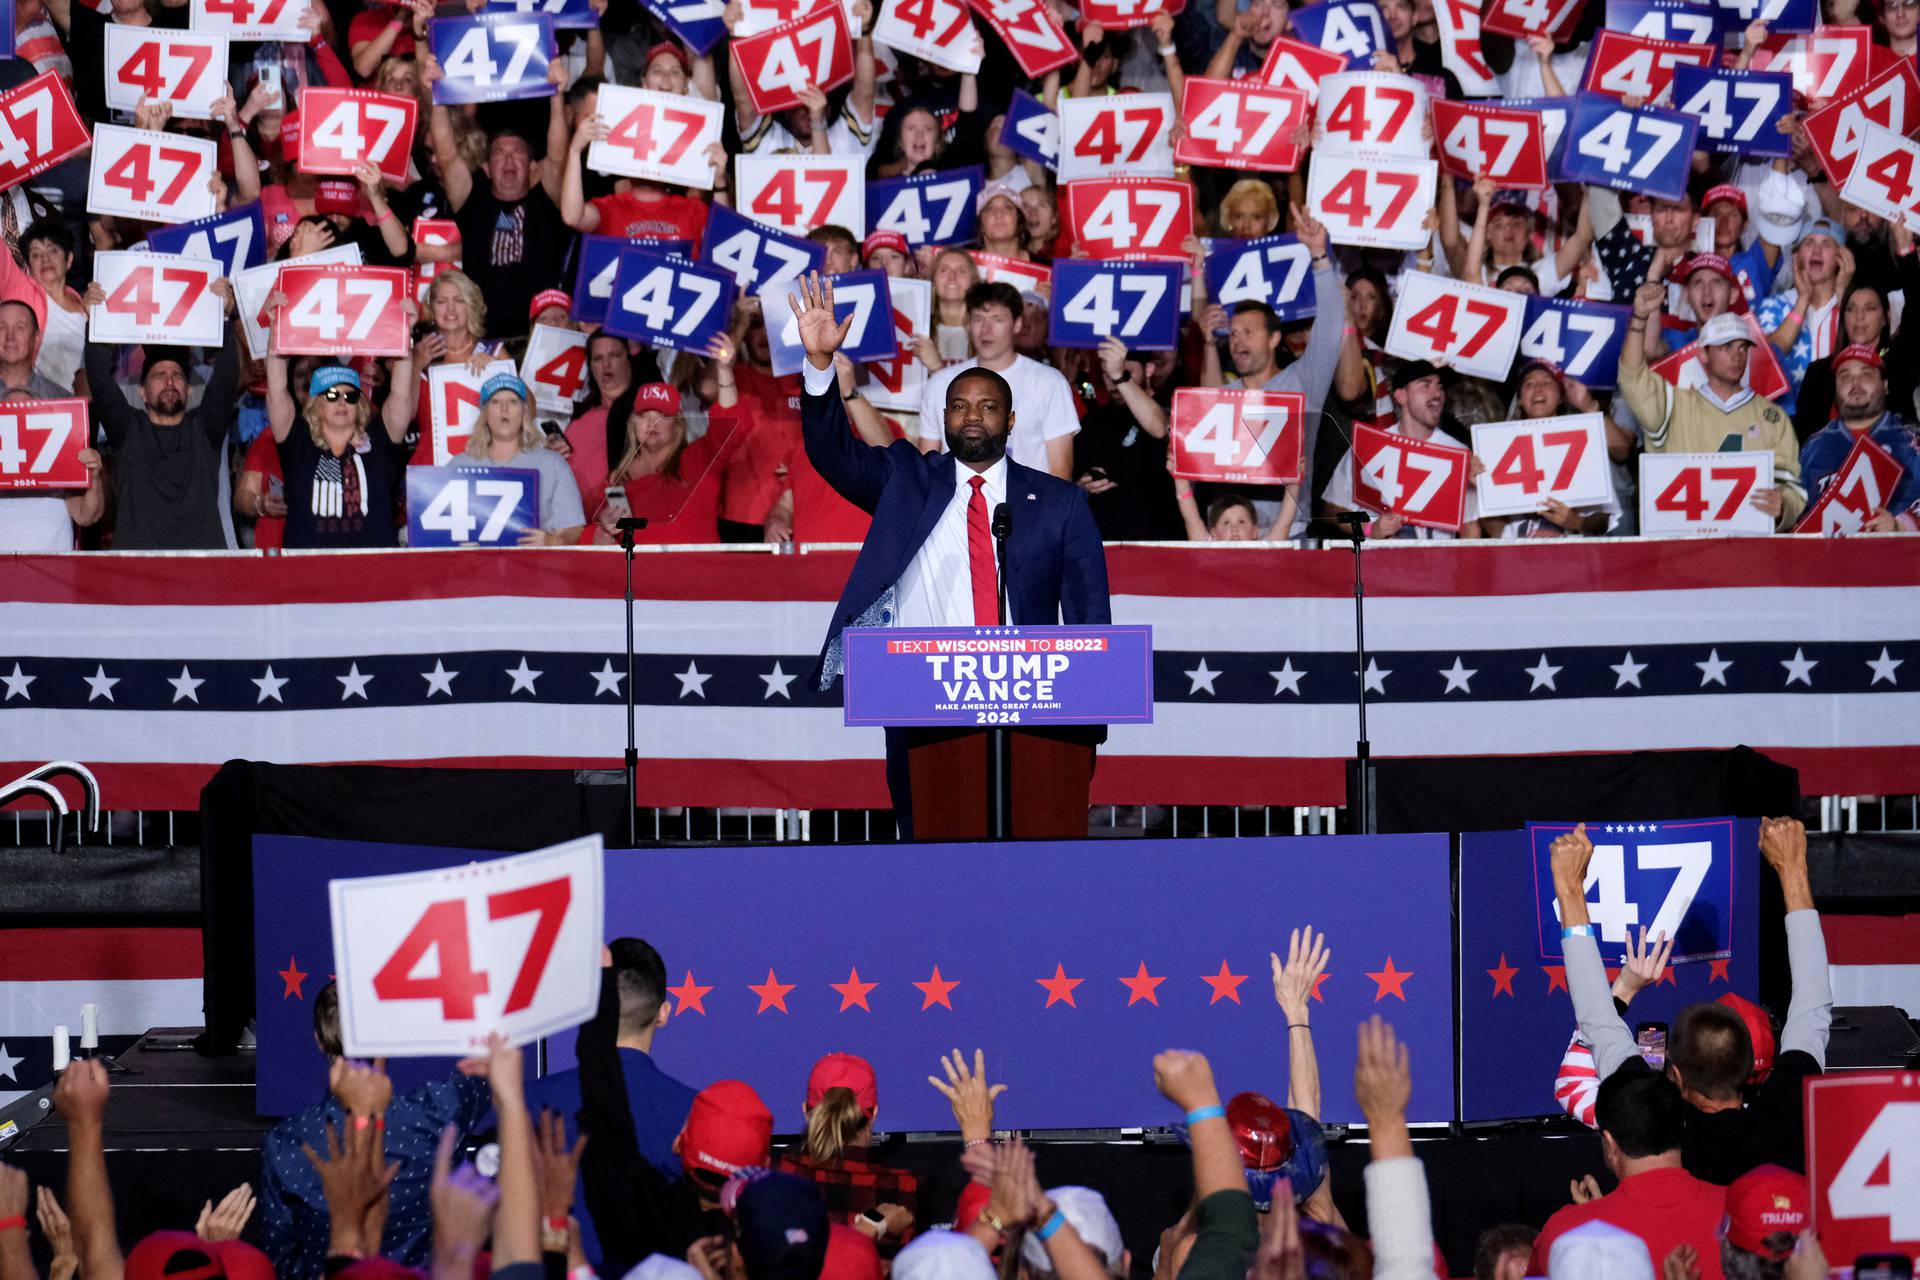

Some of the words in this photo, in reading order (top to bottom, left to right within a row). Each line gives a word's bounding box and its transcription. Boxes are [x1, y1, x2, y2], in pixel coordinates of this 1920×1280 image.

[894, 0, 970, 47] 47
[1320, 3, 1387, 58] 47
[118, 42, 213, 100] 47
[444, 24, 540, 87] 47
[757, 16, 837, 94] 47
[1765, 38, 1857, 97] 47
[312, 101, 405, 162] 47
[607, 104, 706, 165] 47
[1017, 113, 1058, 158] 4
[1074, 108, 1163, 164] 47
[1189, 92, 1291, 156] 47
[1327, 86, 1414, 143] 47
[1681, 80, 1780, 141] 47
[1830, 73, 1905, 159] 47
[30, 160, 50, 176] 2024
[104, 143, 202, 206] 47
[1443, 116, 1529, 176] 47
[1579, 110, 1683, 179] 47
[1717, 144, 1738, 152] 2024
[752, 169, 847, 225] 47
[1321, 169, 1419, 230] 47
[1611, 179, 1632, 189] 2024
[1866, 148, 1920, 212] 4
[139, 210, 160, 218] 2024
[876, 180, 971, 245] 47
[1082, 189, 1181, 249] 47
[712, 228, 811, 296] 47
[1218, 243, 1313, 305] 47
[106, 266, 208, 326] 47
[288, 278, 392, 340] 47
[622, 266, 721, 336] 47
[1063, 274, 1167, 337] 47
[1406, 294, 1508, 358] 47
[146, 333, 167, 341] 2024
[331, 345, 352, 353] 2024
[653, 336, 674, 347] 2024
[1521, 310, 1615, 376] 47
[642, 387, 670, 402] USA
[1185, 403, 1288, 467] 47
[1491, 430, 1587, 494] 47
[1360, 445, 1453, 512] 47
[1655, 467, 1756, 520] 47
[420, 480, 523, 541] 47
[893, 641, 932, 653] TEXT
[936, 640, 1026, 652] WISCONSIN
[1030, 640, 1051, 651] TO
[1055, 639, 1103, 651] 88022
[926, 654, 1070, 680] TRUMP
[935, 703, 960, 711] MAKE
[942, 680, 1053, 701] VANCE
[976, 711, 1021, 724] 2024
[1553, 841, 1712, 942] 47
[372, 875, 572, 1021] 47
[1828, 1101, 1920, 1243] 4
[1760, 1211, 1804, 1225] TRUMP
